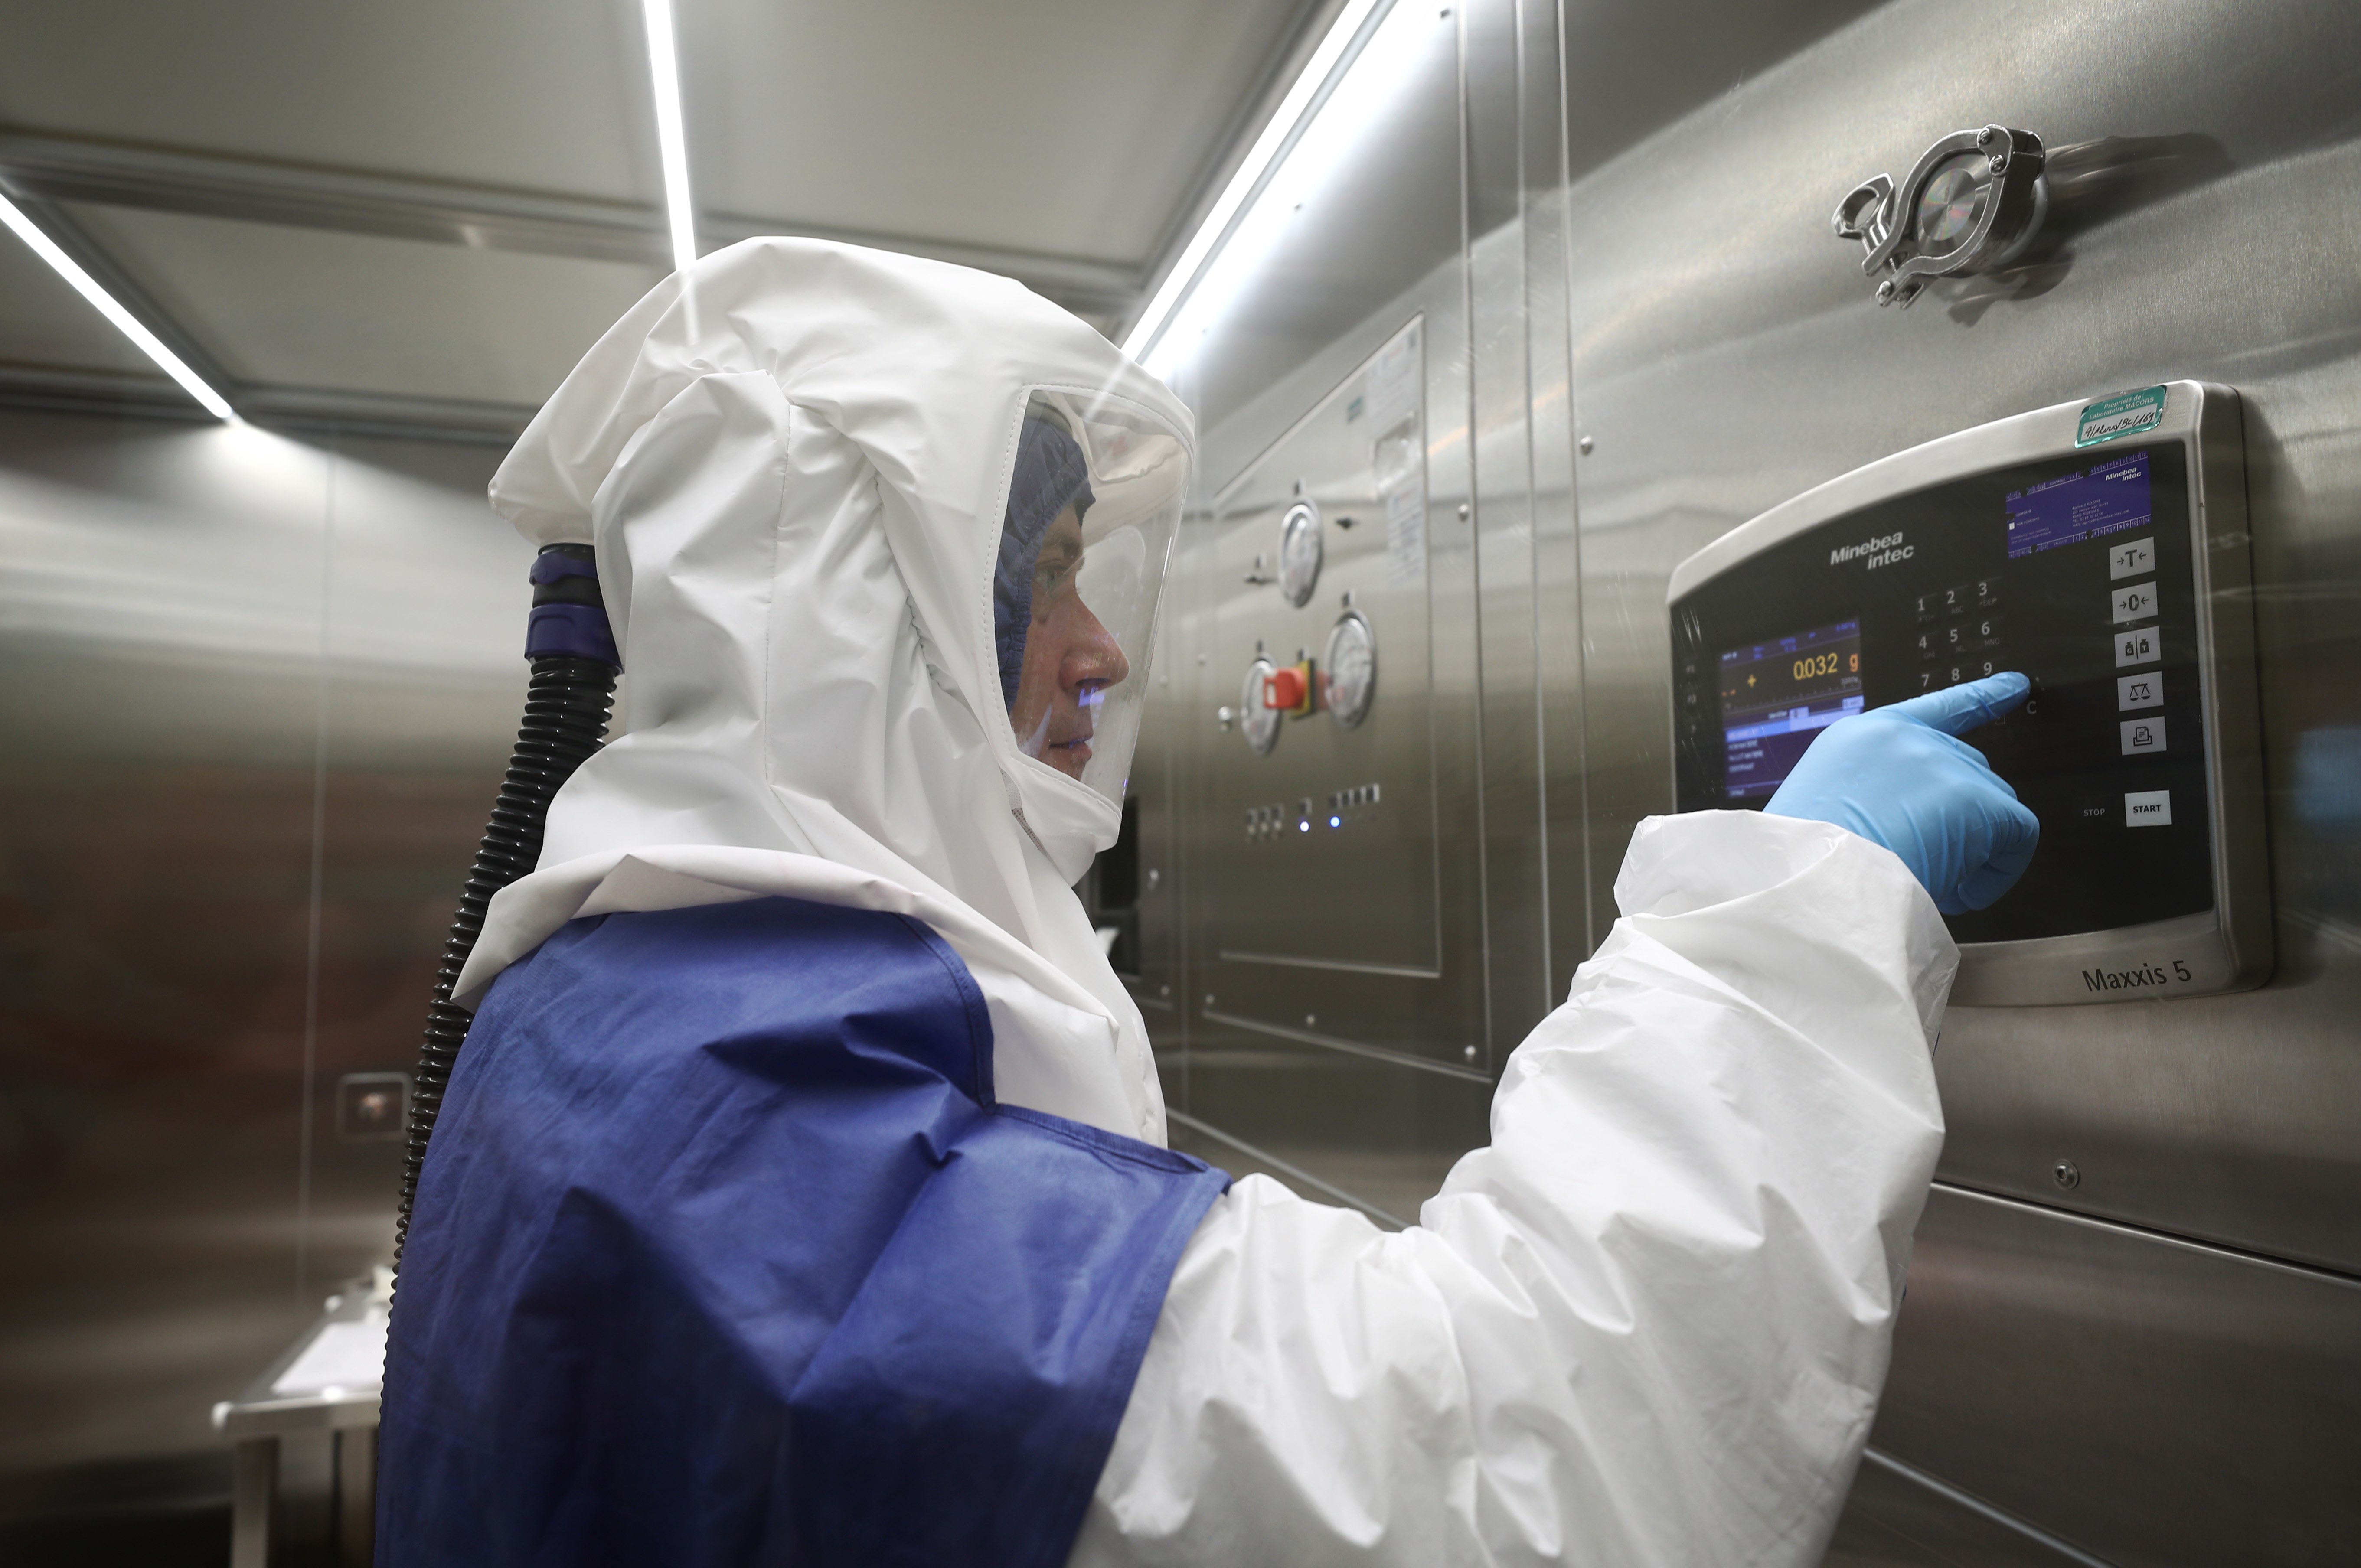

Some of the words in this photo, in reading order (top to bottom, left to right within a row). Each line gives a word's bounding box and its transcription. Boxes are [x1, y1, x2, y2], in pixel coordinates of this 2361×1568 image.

[2089, 407, 2124, 420] Laboratoire
[2125, 397, 2154, 409] MACORS
[2104, 398, 2132, 409] Propriété
[2106, 467, 2137, 480] Minebea
[2122, 472, 2141, 481] intec
[1830, 531, 1903, 565] Minebea
[1867, 545, 1914, 570] intec
[2125, 549, 2137, 567] T
[1918, 598, 1925, 612] 1
[1947, 590, 1955, 604] 2
[1979, 582, 1987, 596] 3
[1951, 606, 1963, 614] ABC
[1919, 636, 1927, 649] 4
[1950, 629, 1958, 642] 5
[1981, 621, 1990, 635] 6
[1985, 638, 2000, 647] MNO
[1849, 653, 1858, 672] g
[1922, 674, 1930, 687] 7
[1951, 668, 1960, 681] 8
[1983, 662, 1992, 675] 9
[2027, 701, 2037, 714] C
[2133, 805, 2161, 813] START
[2082, 963, 2167, 991] Maxxis
[2172, 960, 2191, 981] 5
